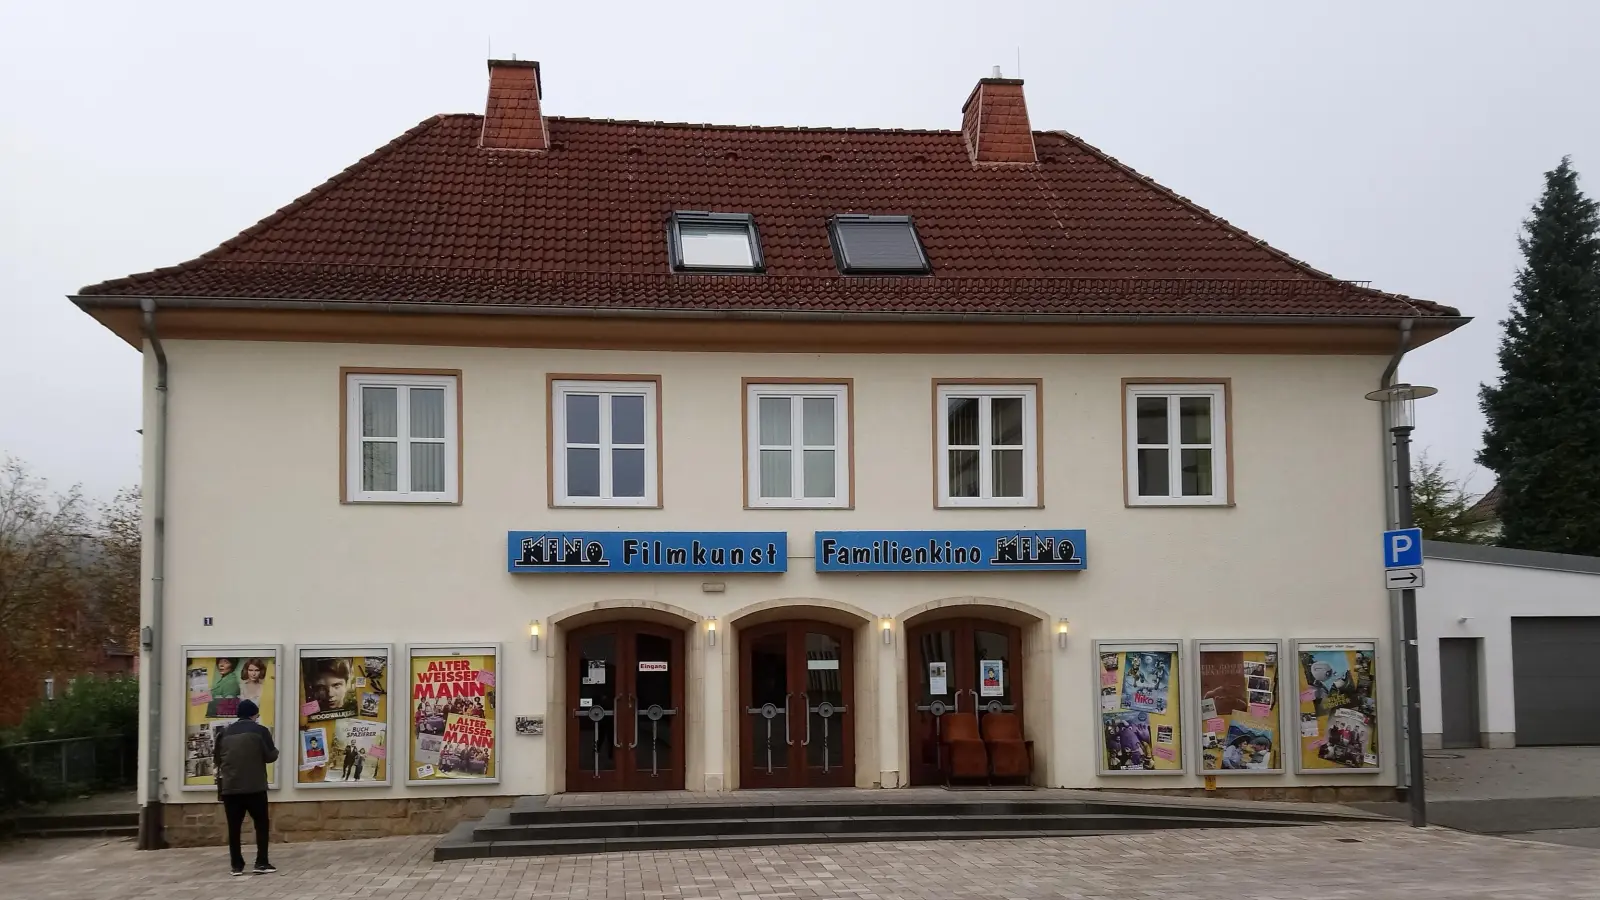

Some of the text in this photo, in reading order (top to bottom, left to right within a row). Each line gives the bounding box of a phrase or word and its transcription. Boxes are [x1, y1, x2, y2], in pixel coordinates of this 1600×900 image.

[514, 535, 778, 567] KINO Filmkunst
[822, 533, 1082, 565] Familienkino KINO
[1392, 535, 1413, 563] P
[427, 660, 470, 672] ALTER
[414, 682, 486, 699] MANN
[1134, 693, 1154, 705] Niko
[448, 723, 493, 737] WEISSER
[456, 717, 487, 729] ALTER
[443, 730, 494, 749] MANN
